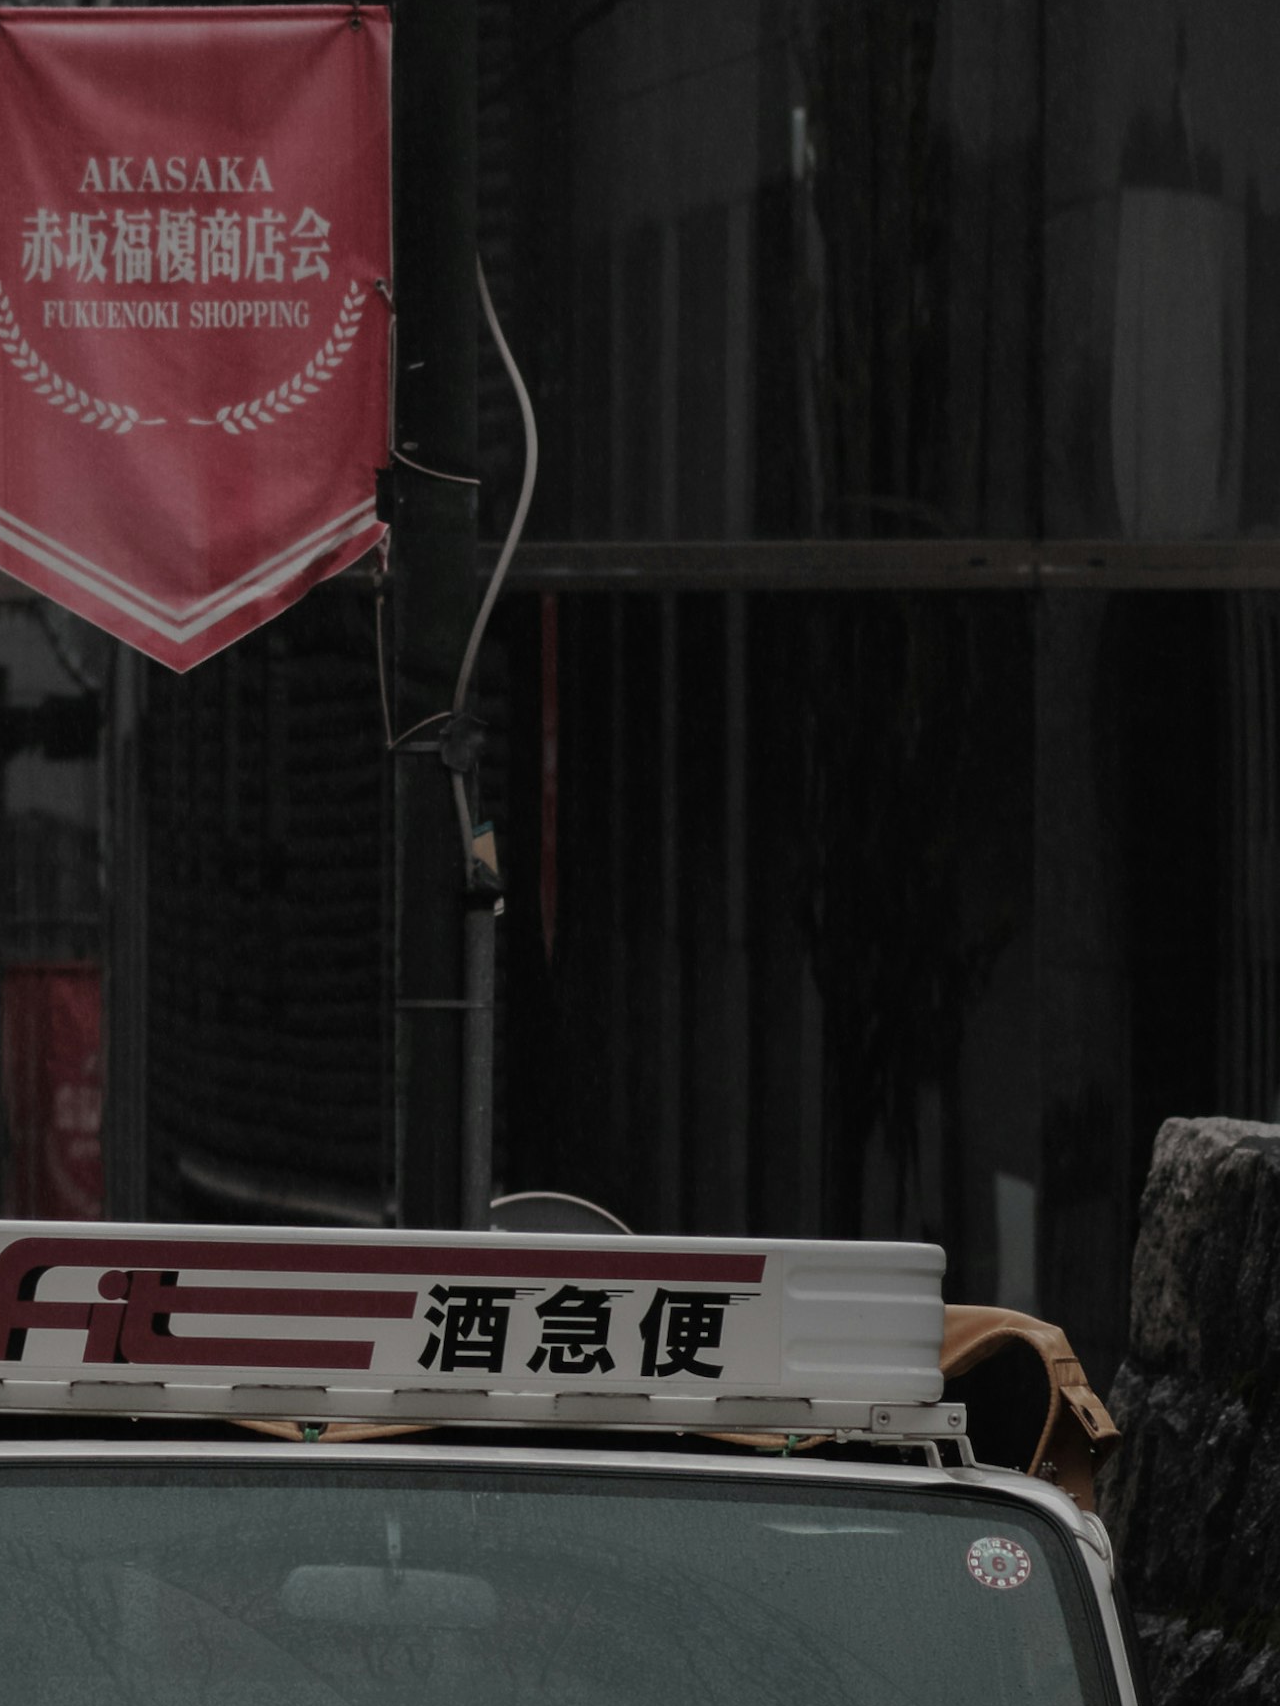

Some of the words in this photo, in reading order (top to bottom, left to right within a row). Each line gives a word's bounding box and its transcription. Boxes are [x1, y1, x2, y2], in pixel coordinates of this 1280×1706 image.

[79, 156, 274, 193] AKASAKA
[21, 206, 332, 284] 赤坂福榎商店会
[43, 301, 180, 329] FUKUENOKI
[189, 300, 310, 329] SHOPPING
[416, 1282, 746, 1379] 酒急便
[992, 1556, 1007, 1573] 6
